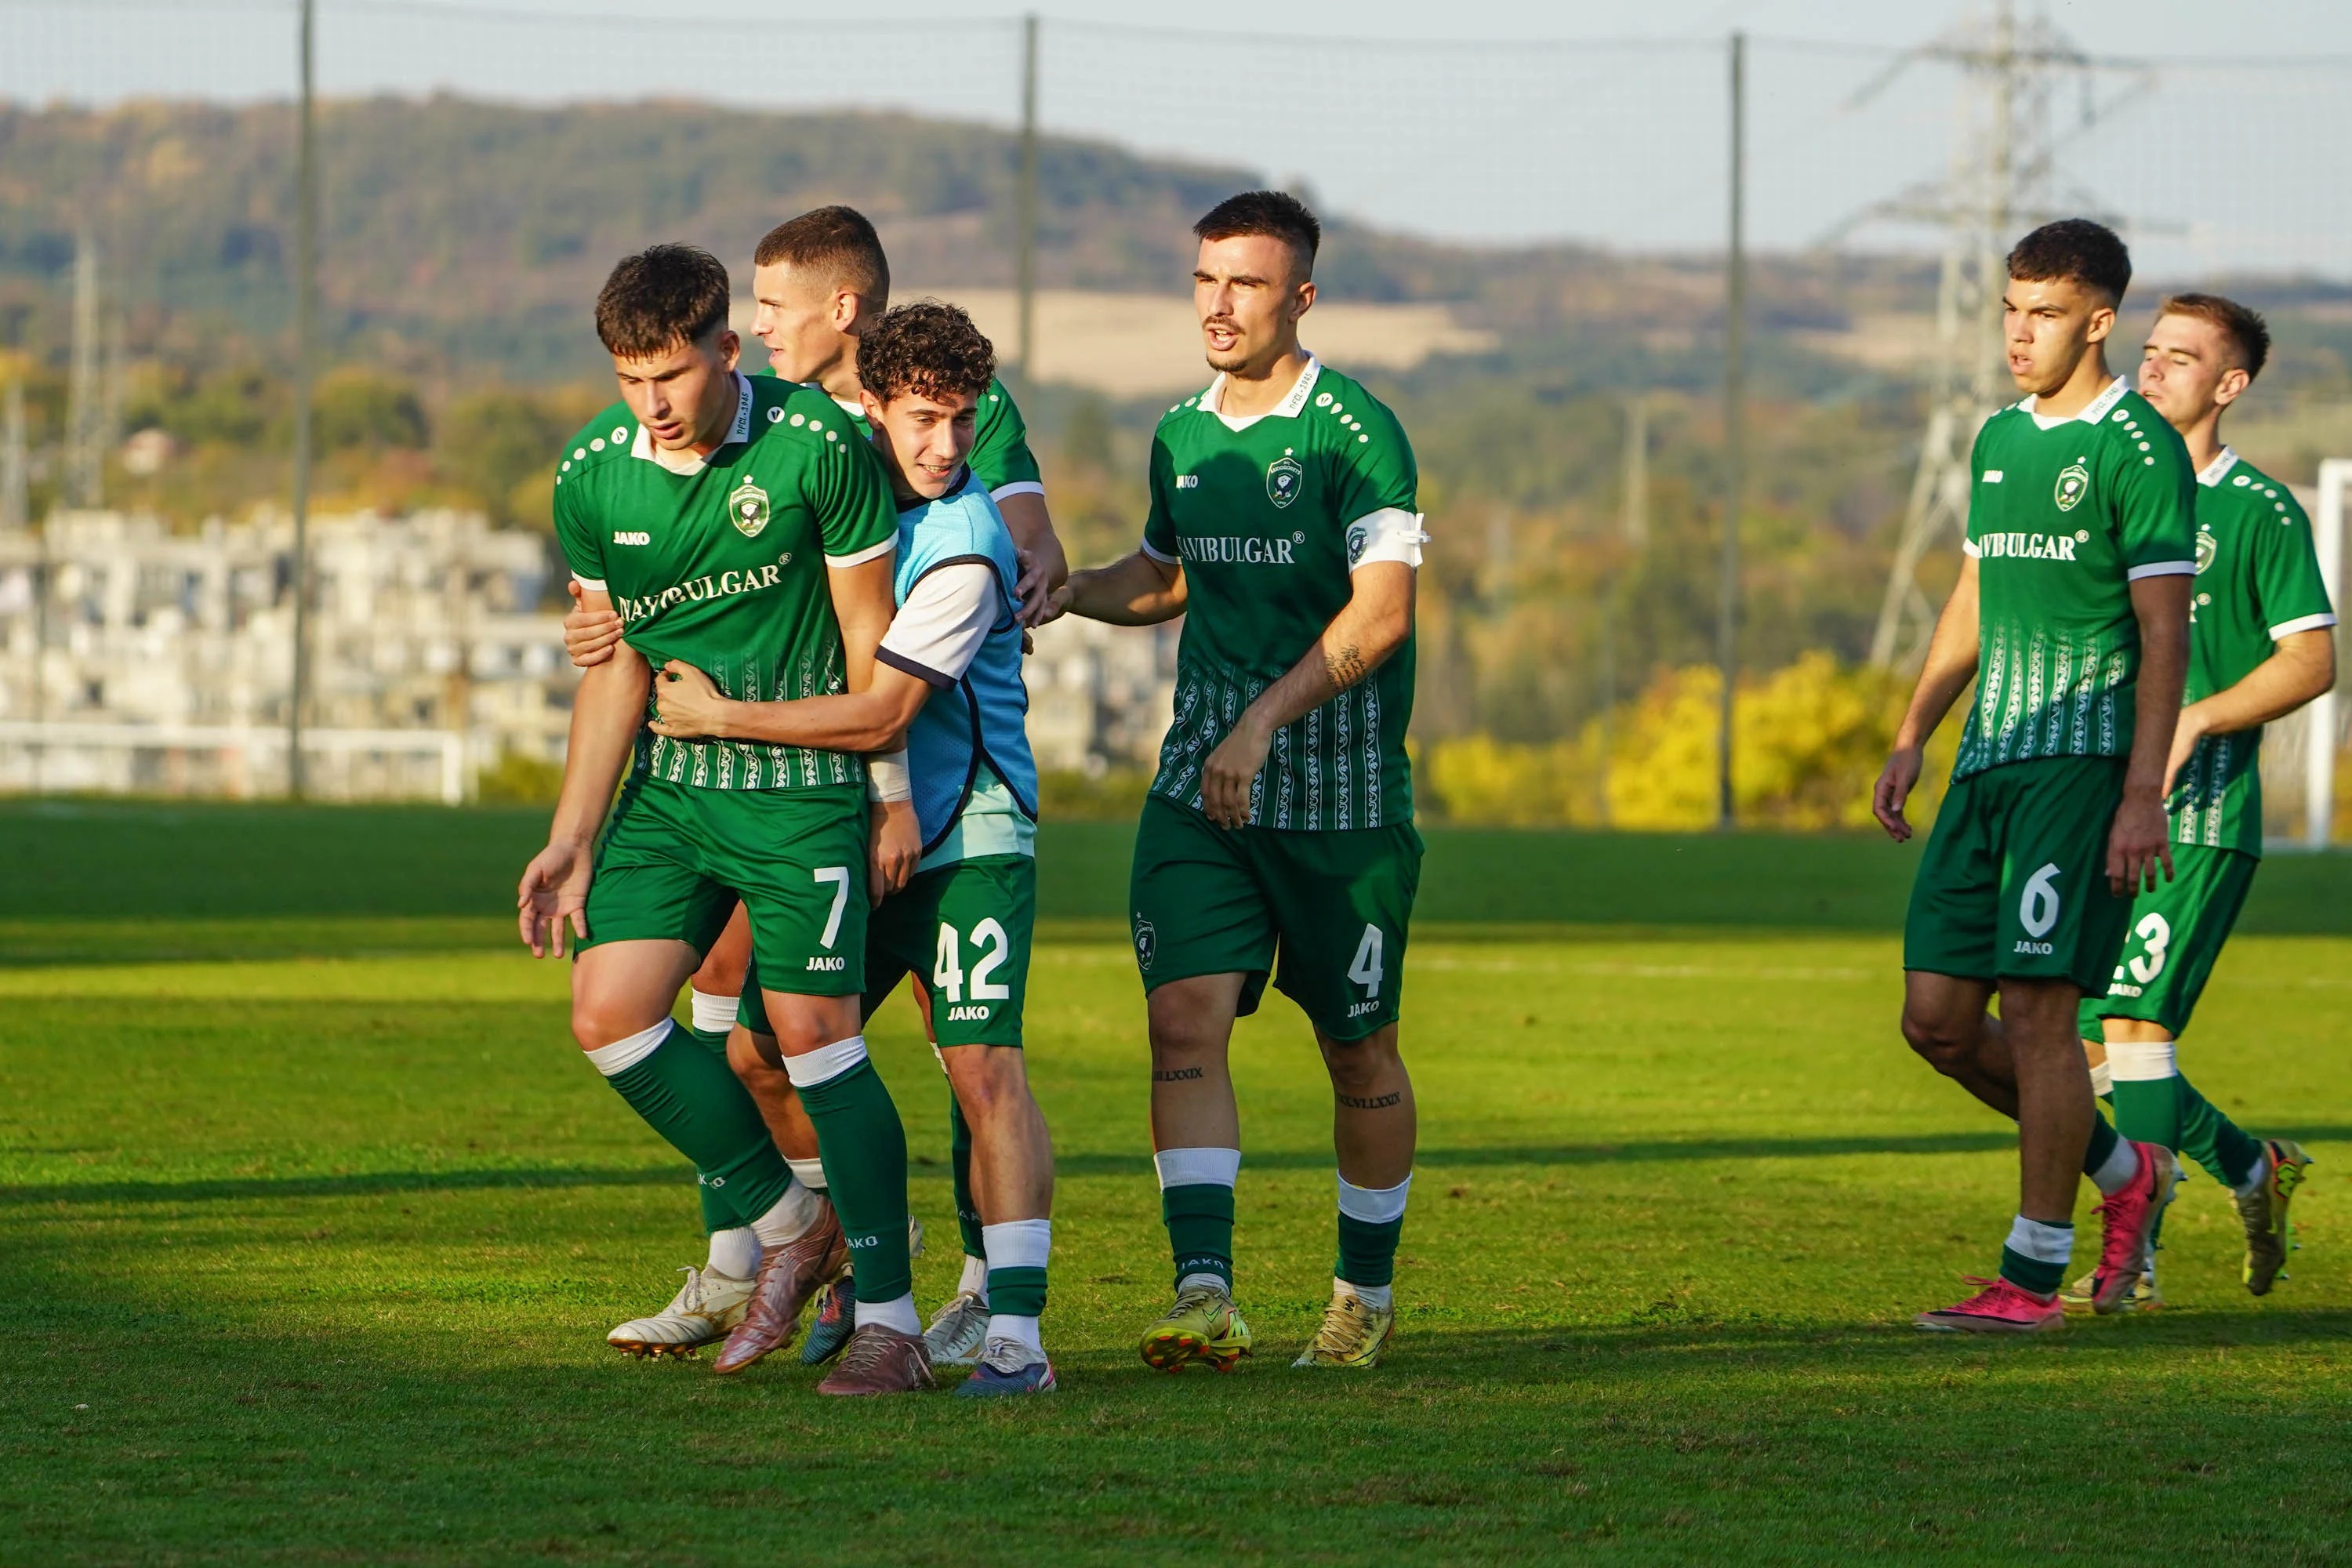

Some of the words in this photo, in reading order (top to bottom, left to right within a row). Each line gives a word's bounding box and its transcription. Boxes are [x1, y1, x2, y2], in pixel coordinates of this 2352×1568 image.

[613, 531, 651, 546] JAKO
[813, 866, 850, 949] 7
[2019, 862, 2062, 938] 6
[2013, 940, 2053, 955] JAKO
[806, 956, 846, 971] JAKO
[933, 916, 1010, 1003] 42
[1347, 922, 1384, 999] 4
[947, 1006, 990, 1021] JAKO
[1347, 1000, 1380, 1018] JAKO
